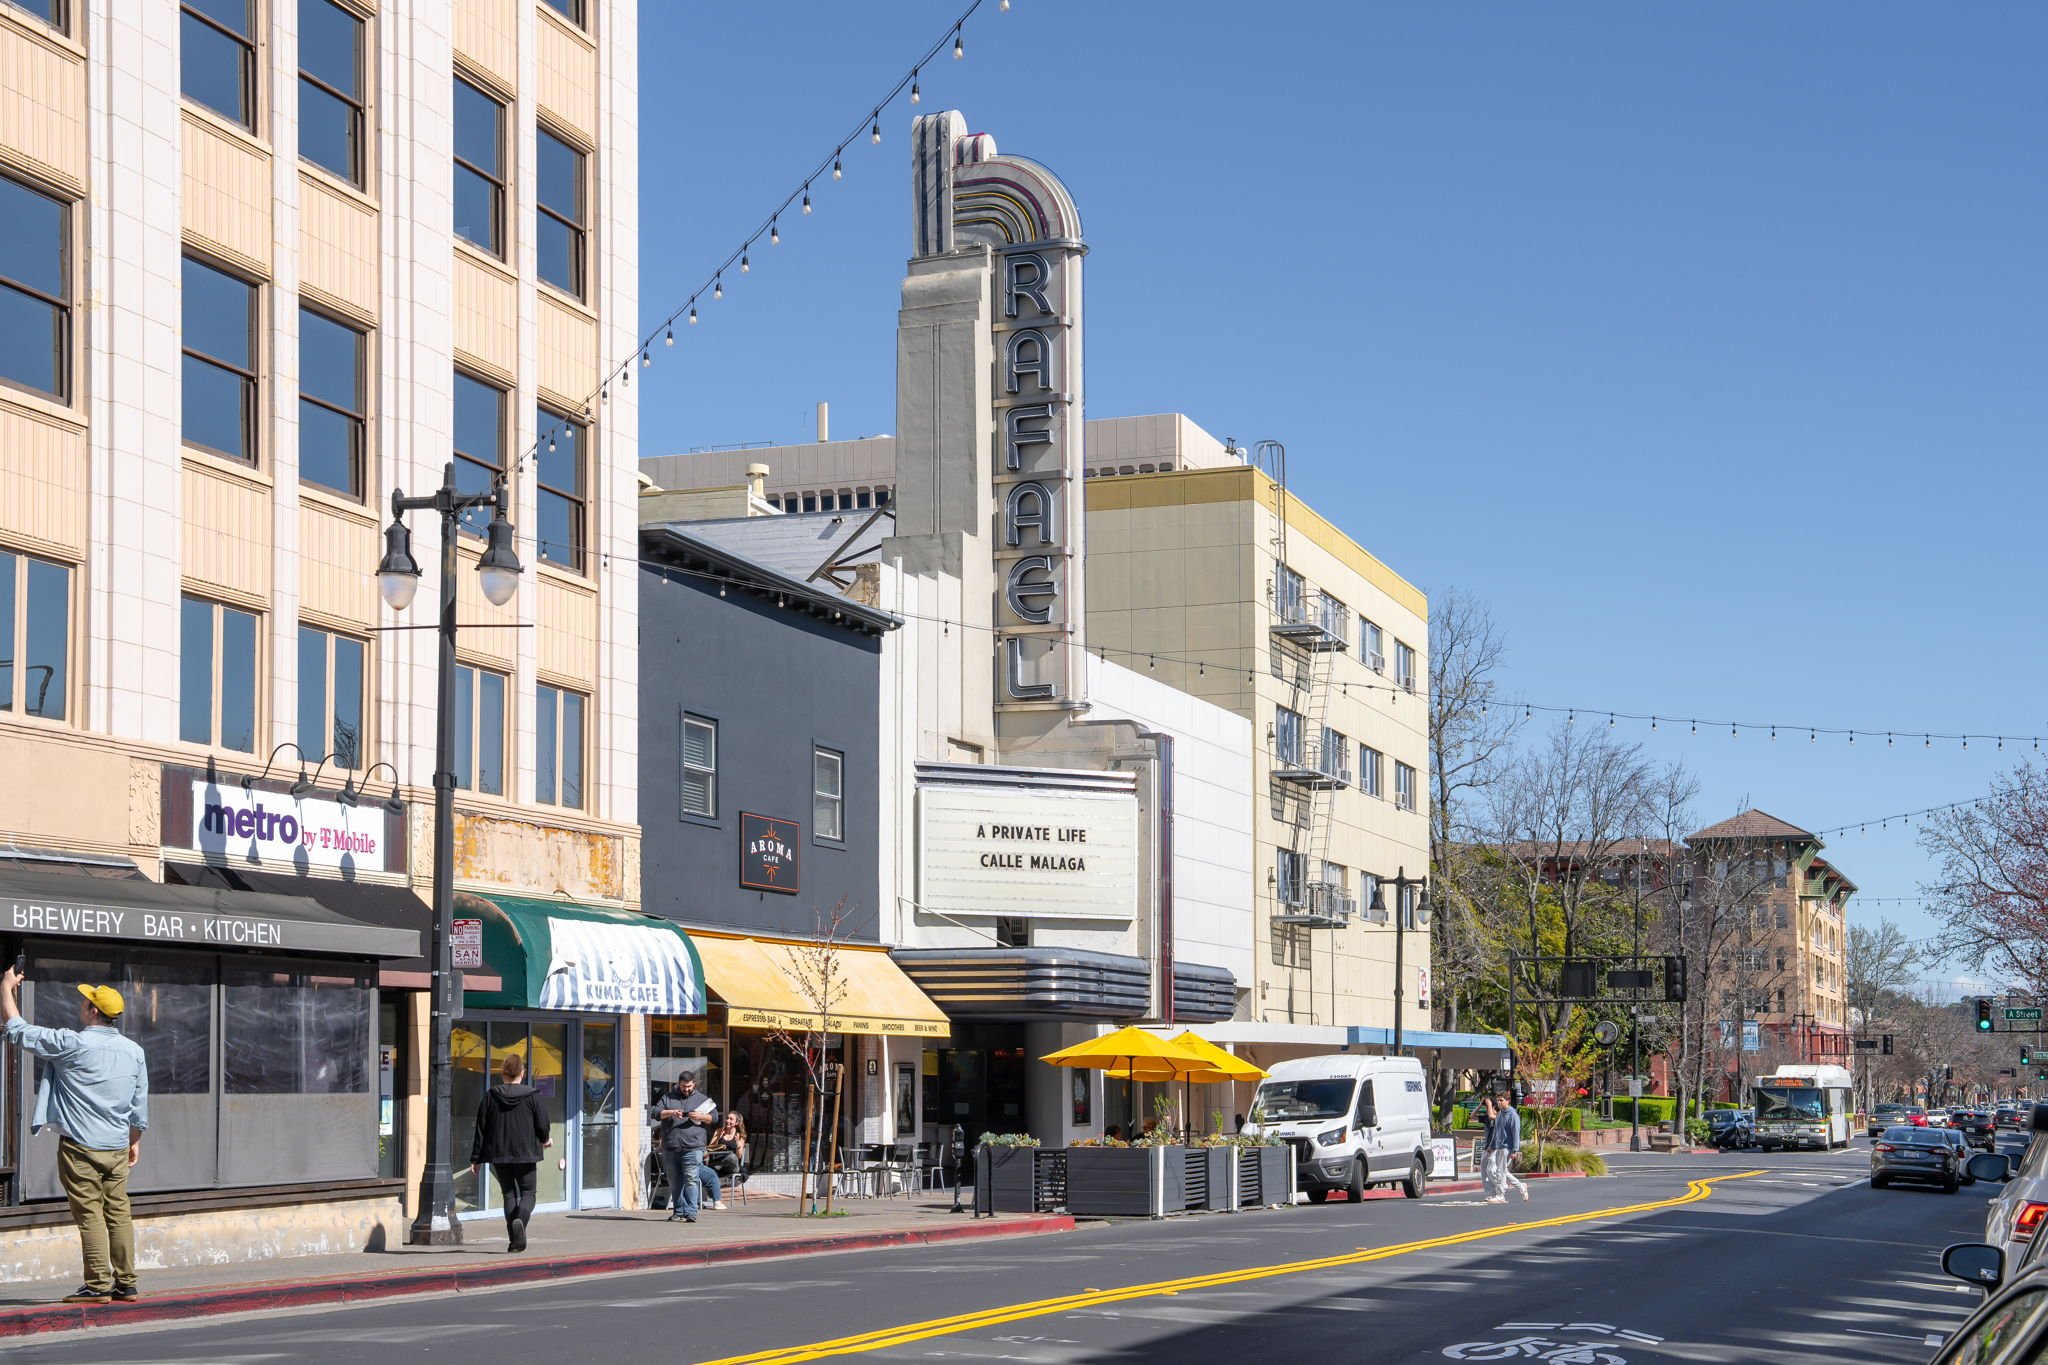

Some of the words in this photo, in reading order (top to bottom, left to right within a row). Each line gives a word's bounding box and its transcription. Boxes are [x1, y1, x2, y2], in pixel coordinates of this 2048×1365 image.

[1004, 253, 1058, 699] RAFAEL
[205, 803, 298, 844] metro
[301, 825, 317, 852] by
[977, 825, 985, 838] A
[992, 825, 1050, 841] PRIVATE
[1058, 828, 1086, 842] LIFE
[750, 839, 792, 861] AROMA
[763, 854, 778, 863] CAFE
[981, 854, 1022, 868] CALLE
[1030, 856, 1085, 871] MALAGA
[13, 904, 124, 934] BREWERY
[144, 914, 183, 938] BAR
[204, 919, 281, 945] KITCHEN
[453, 925, 463, 935] NO
[455, 950, 479, 958] SAN
[586, 984, 623, 1000] KUMA
[629, 986, 659, 1002] CAFE
[2015, 1010, 2038, 1018] Street
